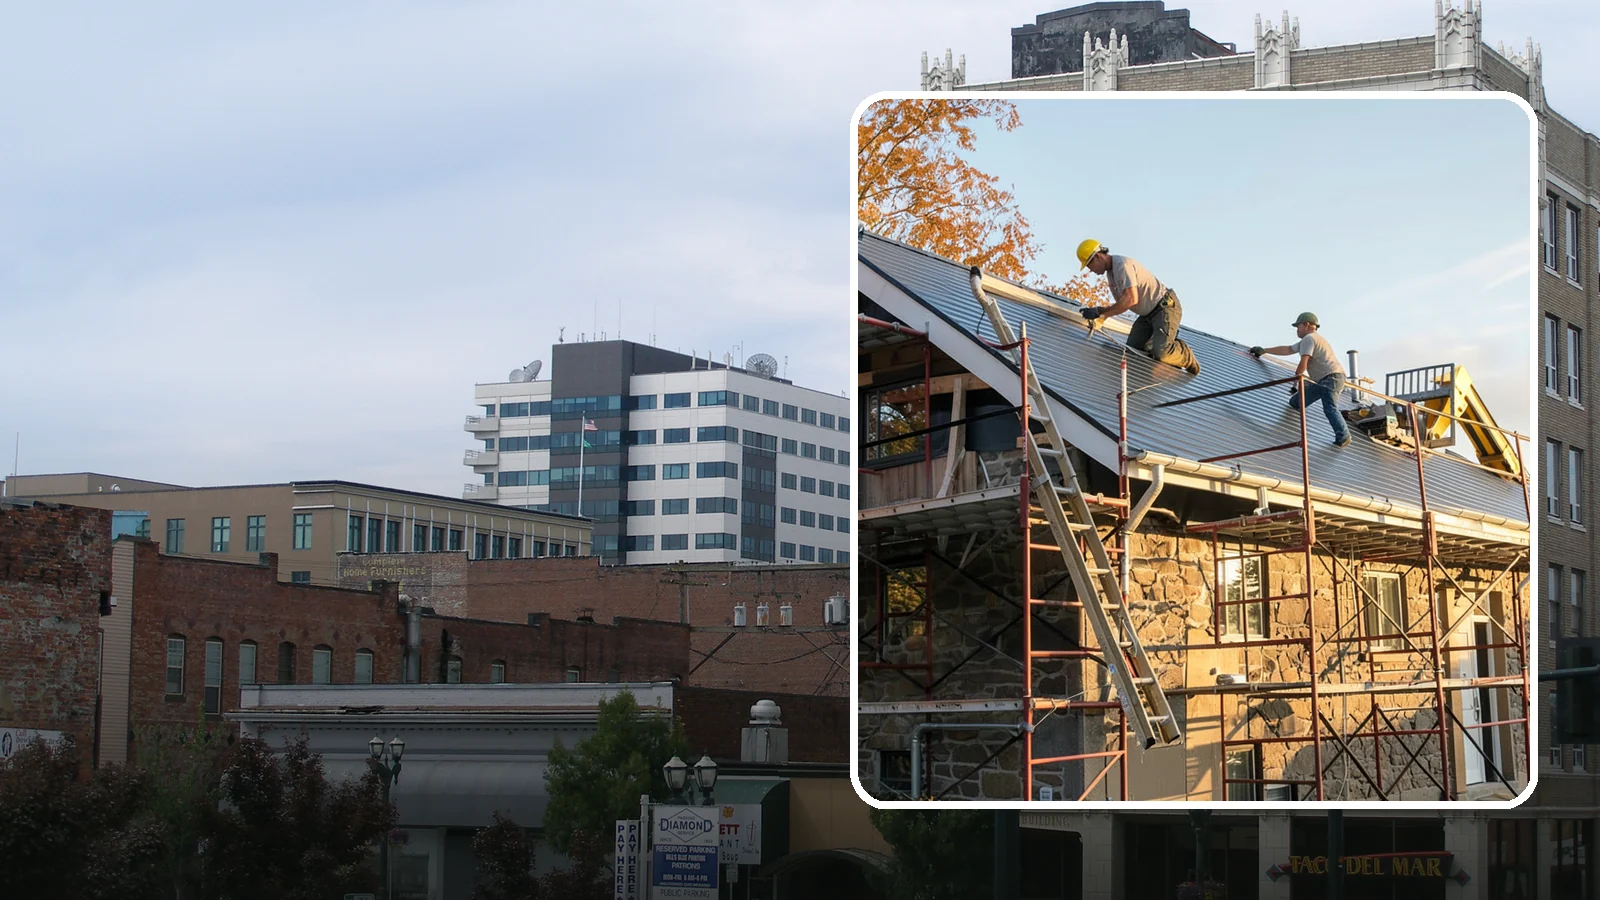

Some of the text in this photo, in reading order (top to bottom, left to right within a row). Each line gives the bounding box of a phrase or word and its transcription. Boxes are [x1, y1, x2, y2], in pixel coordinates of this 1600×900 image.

[370, 566, 427, 576] Furnishers
[660, 818, 713, 832] DIAMOND
[1021, 815, 1069, 828] BUILDING
[617, 825, 625, 852] PAY
[628, 825, 636, 852] PAY
[655, 845, 716, 854] RESERVED PARKING
[721, 851, 739, 861] Soup
[671, 862, 701, 870] PATRONS
[1346, 856, 1385, 875] DEL
[1392, 857, 1442, 877] MAR
[616, 856, 625, 893] HERE
[627, 856, 636, 893] HERE
[660, 888, 710, 899] PUBLIC PARKING
